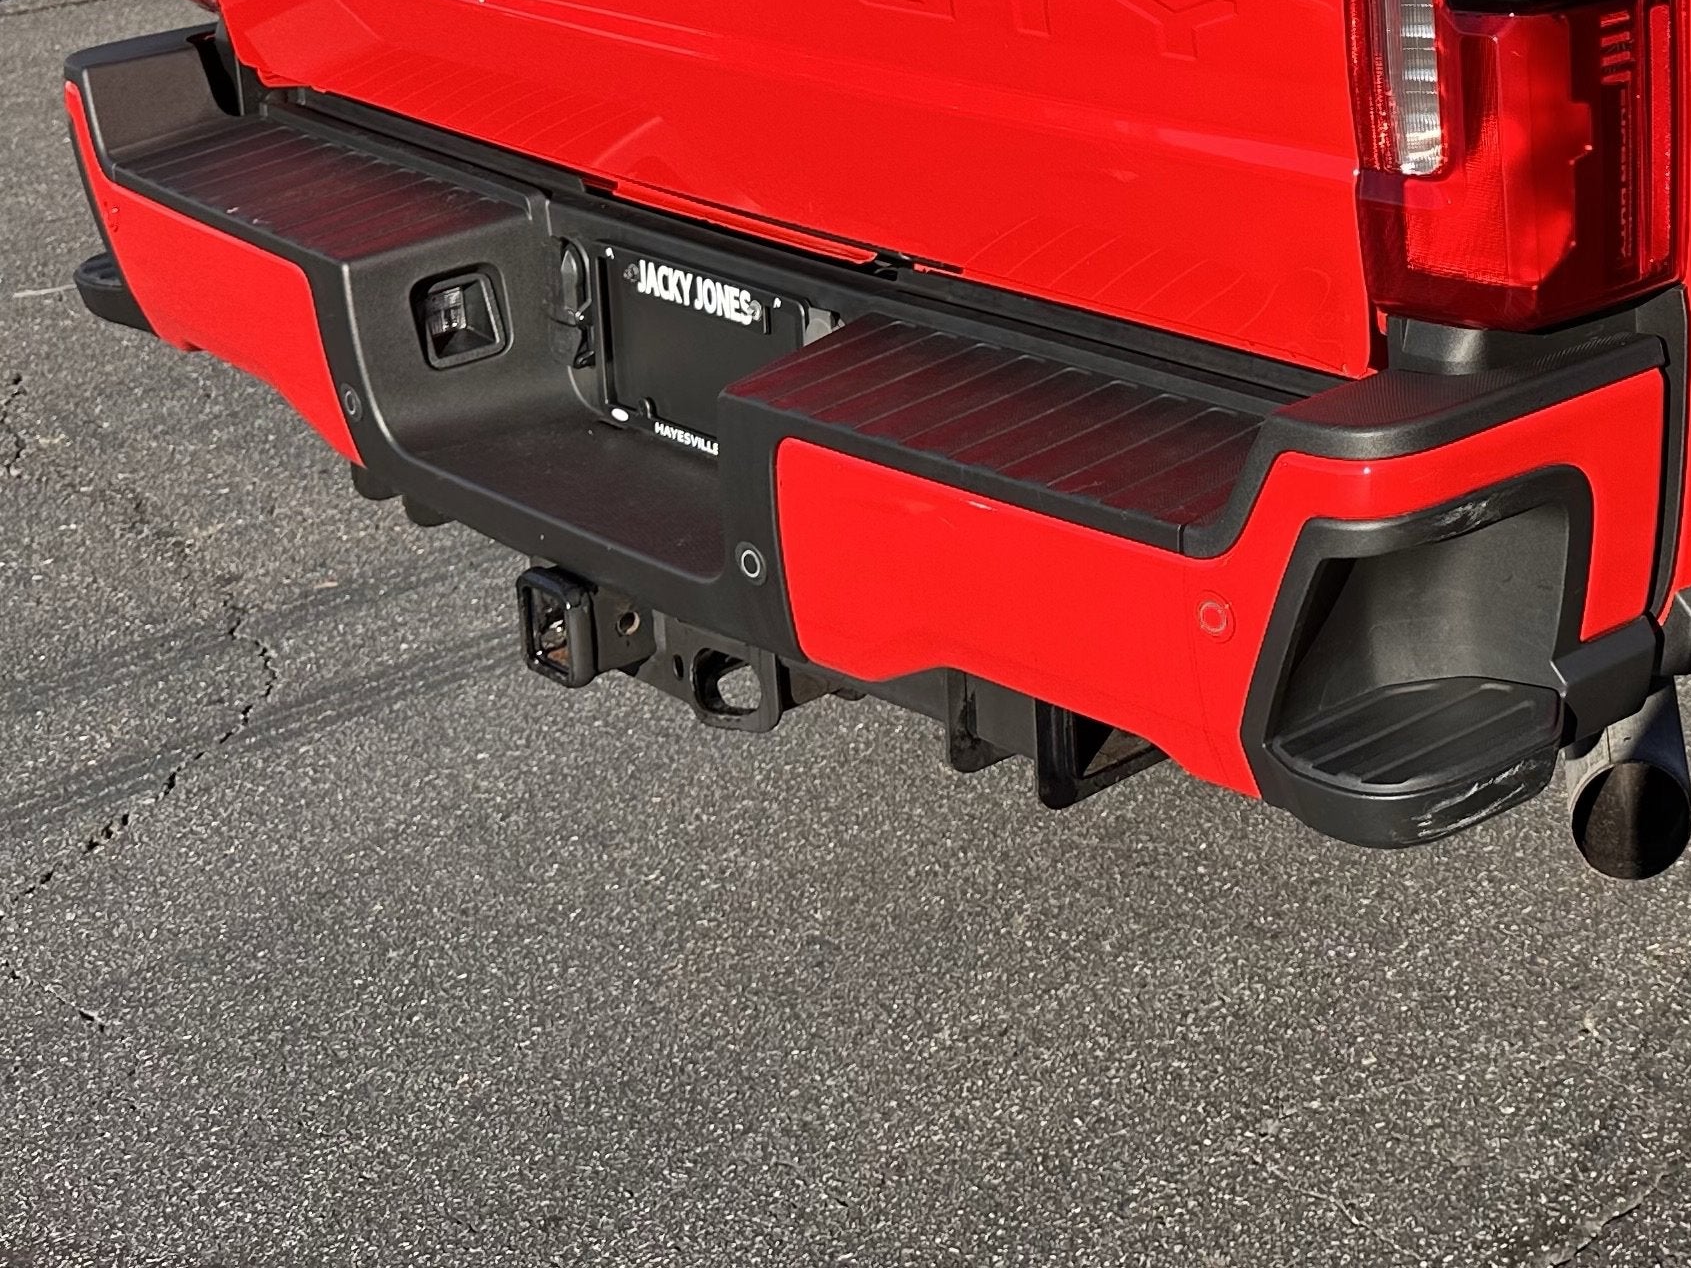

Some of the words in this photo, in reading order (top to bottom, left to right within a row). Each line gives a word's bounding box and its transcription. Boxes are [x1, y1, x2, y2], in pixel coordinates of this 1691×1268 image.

[637, 259, 693, 307] JACKY
[694, 275, 753, 326] JONES
[654, 421, 719, 456] HAYESVILLE
